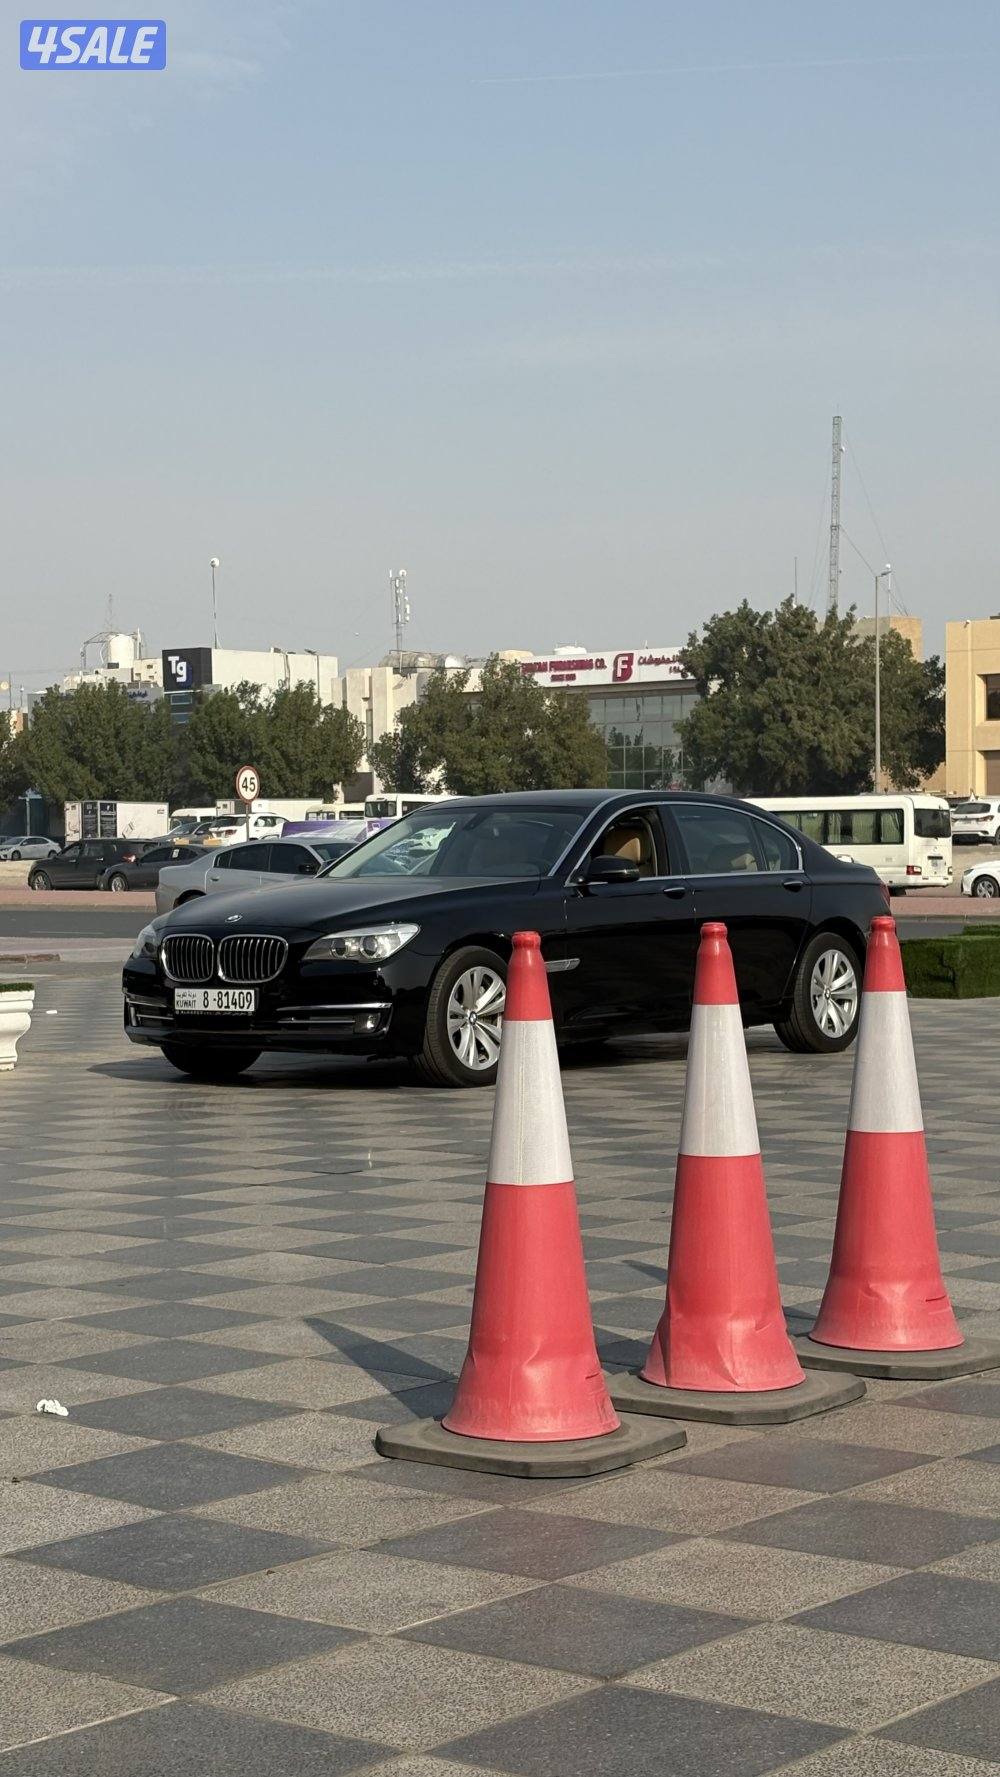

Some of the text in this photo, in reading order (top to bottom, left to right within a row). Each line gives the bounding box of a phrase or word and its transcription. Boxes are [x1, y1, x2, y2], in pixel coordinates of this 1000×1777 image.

[167, 655, 187, 683] Tg
[241, 776, 256, 792] 45
[176, 999, 196, 1008] KUWAIT
